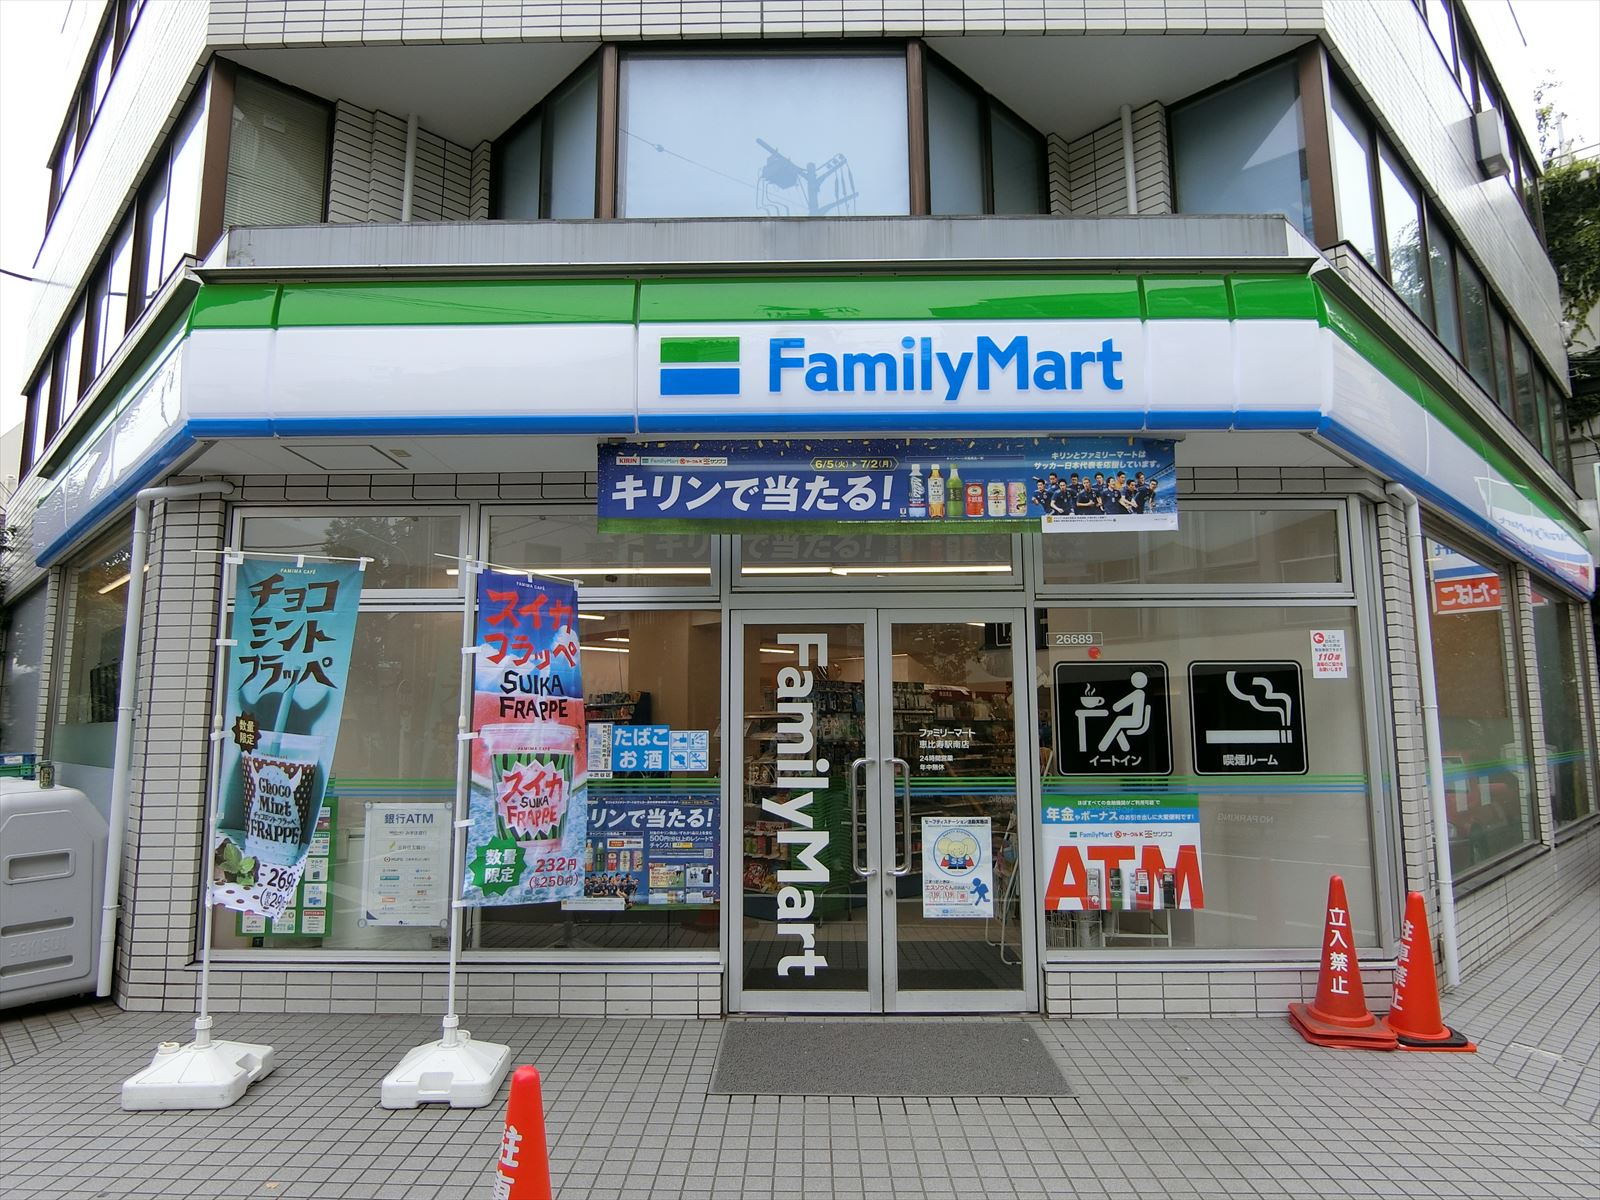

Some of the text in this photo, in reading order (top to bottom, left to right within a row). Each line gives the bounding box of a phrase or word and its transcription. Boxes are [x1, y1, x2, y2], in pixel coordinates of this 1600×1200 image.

[769, 335, 1124, 400] FamilyMart
[815, 460, 893, 469] 6/5(火) 7/2(月)
[1051, 450, 1146, 460] キリンとファミリーマートは
[612, 475, 894, 511] キリンで当たる!
[248, 573, 340, 616] チョコ
[485, 589, 573, 634] スイカ
[250, 617, 336, 654] ミント
[1056, 635, 1094, 645] 26689
[483, 632, 578, 670] フラッペ
[238, 654, 338, 695] フラッペ
[500, 670, 565, 696] SUIKA
[499, 696, 569, 721] FRAPPE
[240, 720, 255, 733] 数量
[918, 728, 976, 738] ファミリーマート
[240, 732, 255, 746] 限定
[614, 727, 669, 747] たばこ
[918, 740, 970, 749] 恵比寿駅南店
[619, 750, 663, 769] お酒
[1089, 755, 1142, 767] イートイン
[1222, 754, 1279, 766] 喫煙ルーム
[502, 771, 562, 803] スイカ
[259, 796, 292, 816] Mint
[519, 795, 549, 808] SUIKA
[761, 633, 830, 976] FamilyMart
[384, 813, 434, 824] 銀行ATM
[507, 805, 558, 827] FRAPPE
[587, 808, 714, 828] リンで当たる!
[250, 819, 300, 844] FRAPPE
[485, 849, 517, 865] 数量
[535, 857, 577, 873] 232円
[267, 868, 297, 891] 269
[484, 867, 515, 884] 限定
[1044, 845, 1205, 911] ATM
[1328, 907, 1349, 995] 立入禁止
